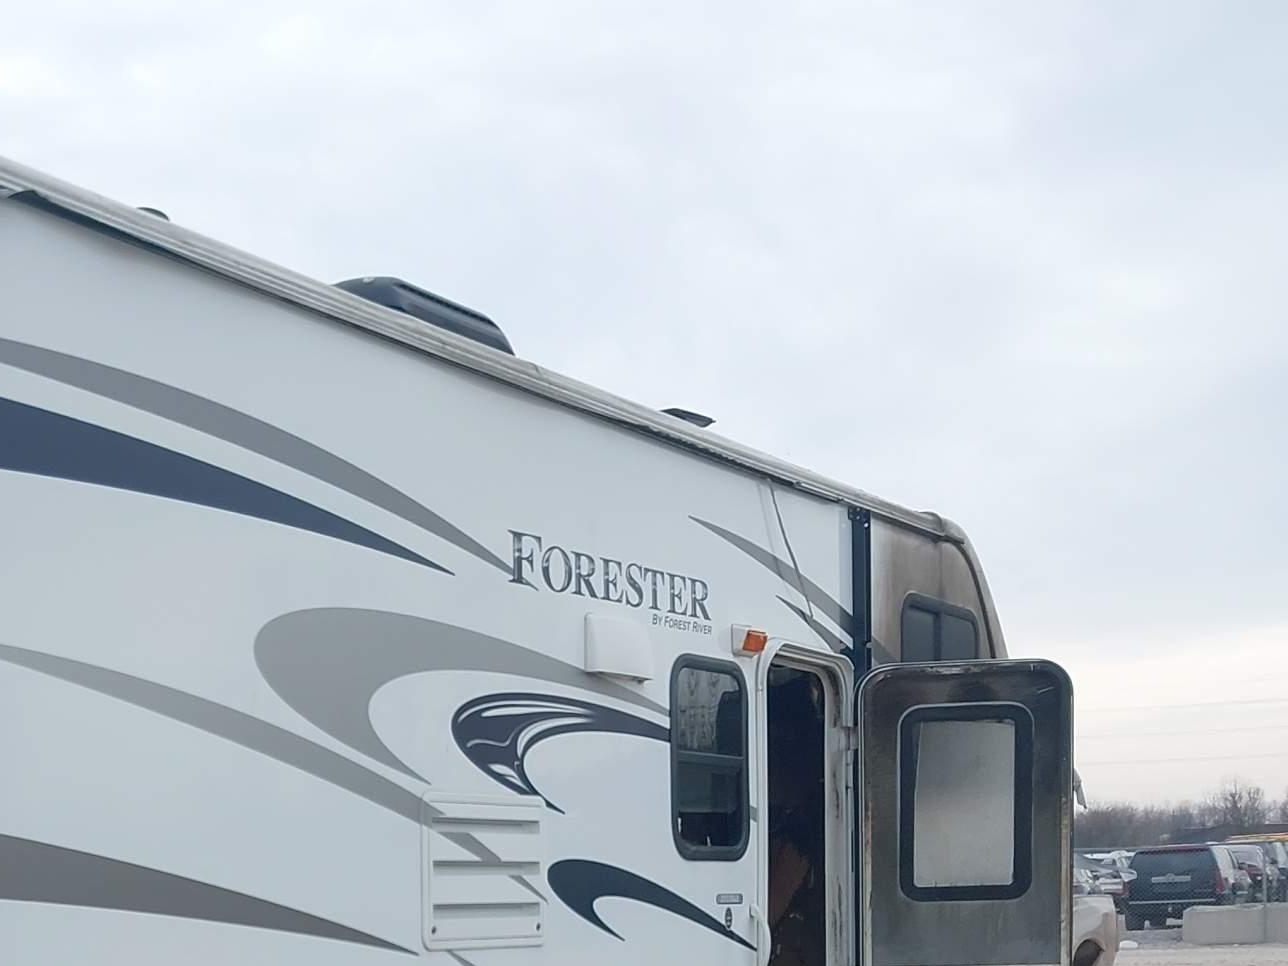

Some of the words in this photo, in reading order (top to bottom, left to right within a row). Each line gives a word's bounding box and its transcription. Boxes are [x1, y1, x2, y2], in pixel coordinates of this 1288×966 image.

[507, 529, 712, 621] FORESTER
[652, 613, 664, 626] BY
[664, 615, 691, 632] FOREST
[692, 620, 712, 636] RIVER
